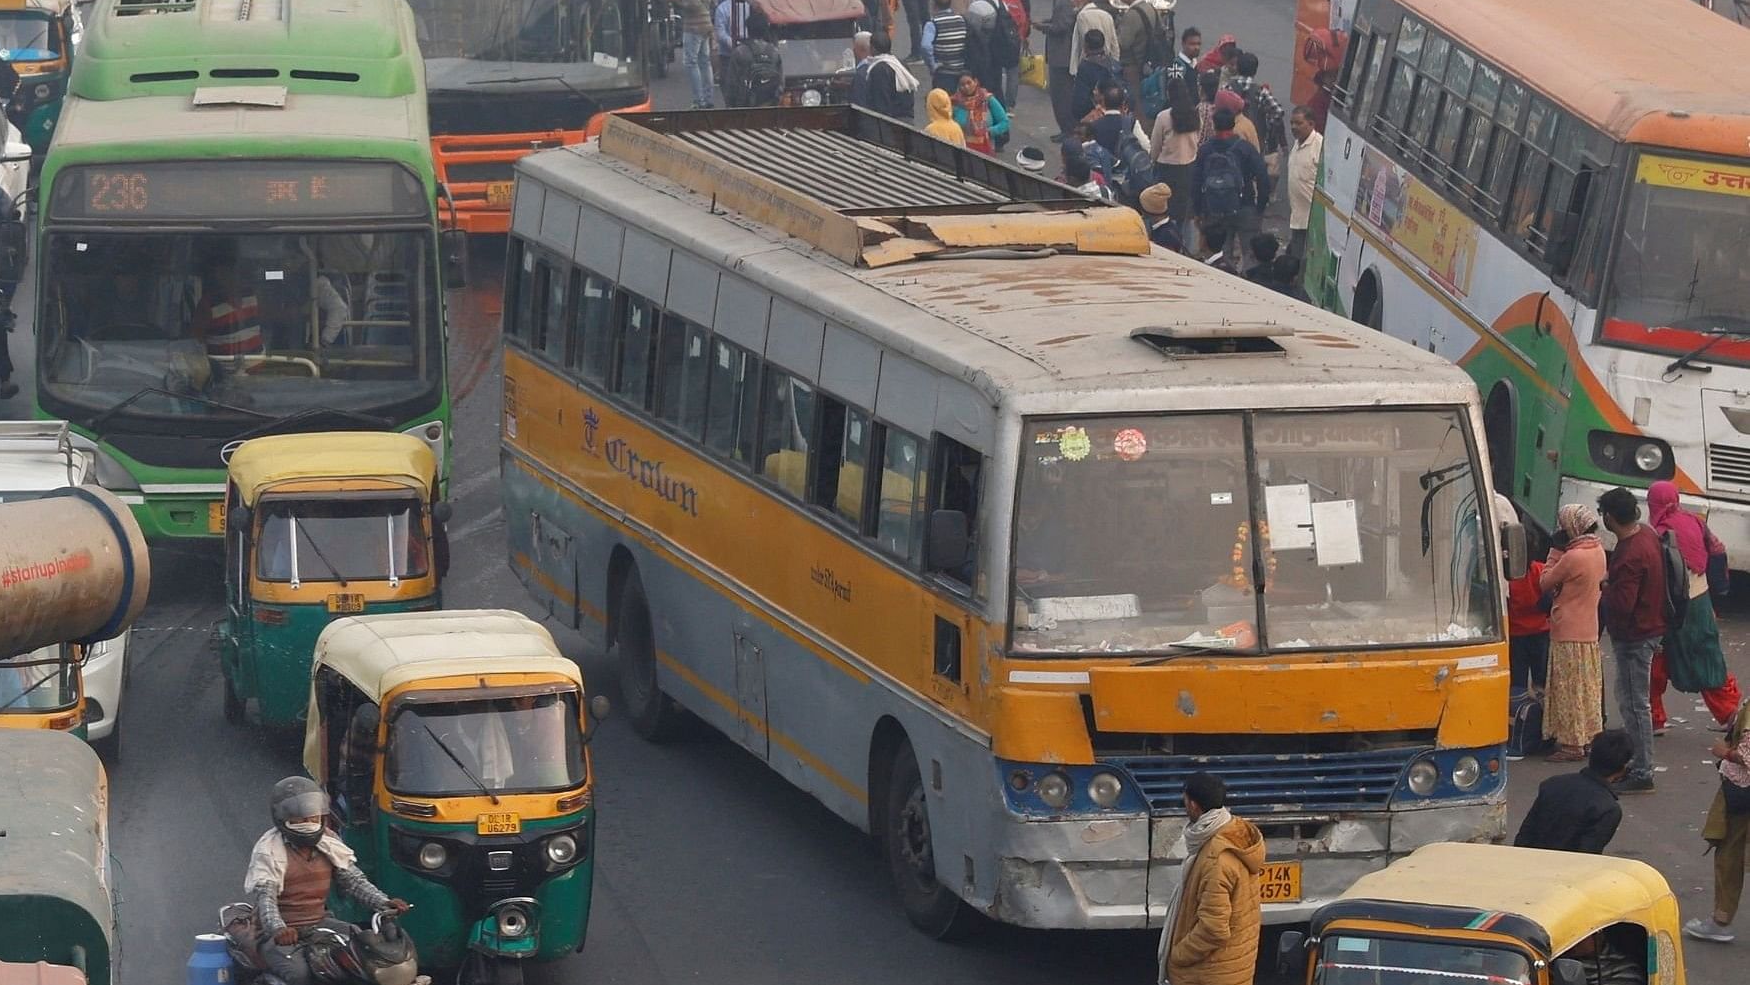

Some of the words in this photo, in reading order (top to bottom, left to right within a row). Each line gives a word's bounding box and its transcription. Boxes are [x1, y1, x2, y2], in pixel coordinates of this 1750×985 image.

[90, 173, 147, 210] 236
[605, 438, 698, 517] Crown
[488, 823, 517, 833] U6279
